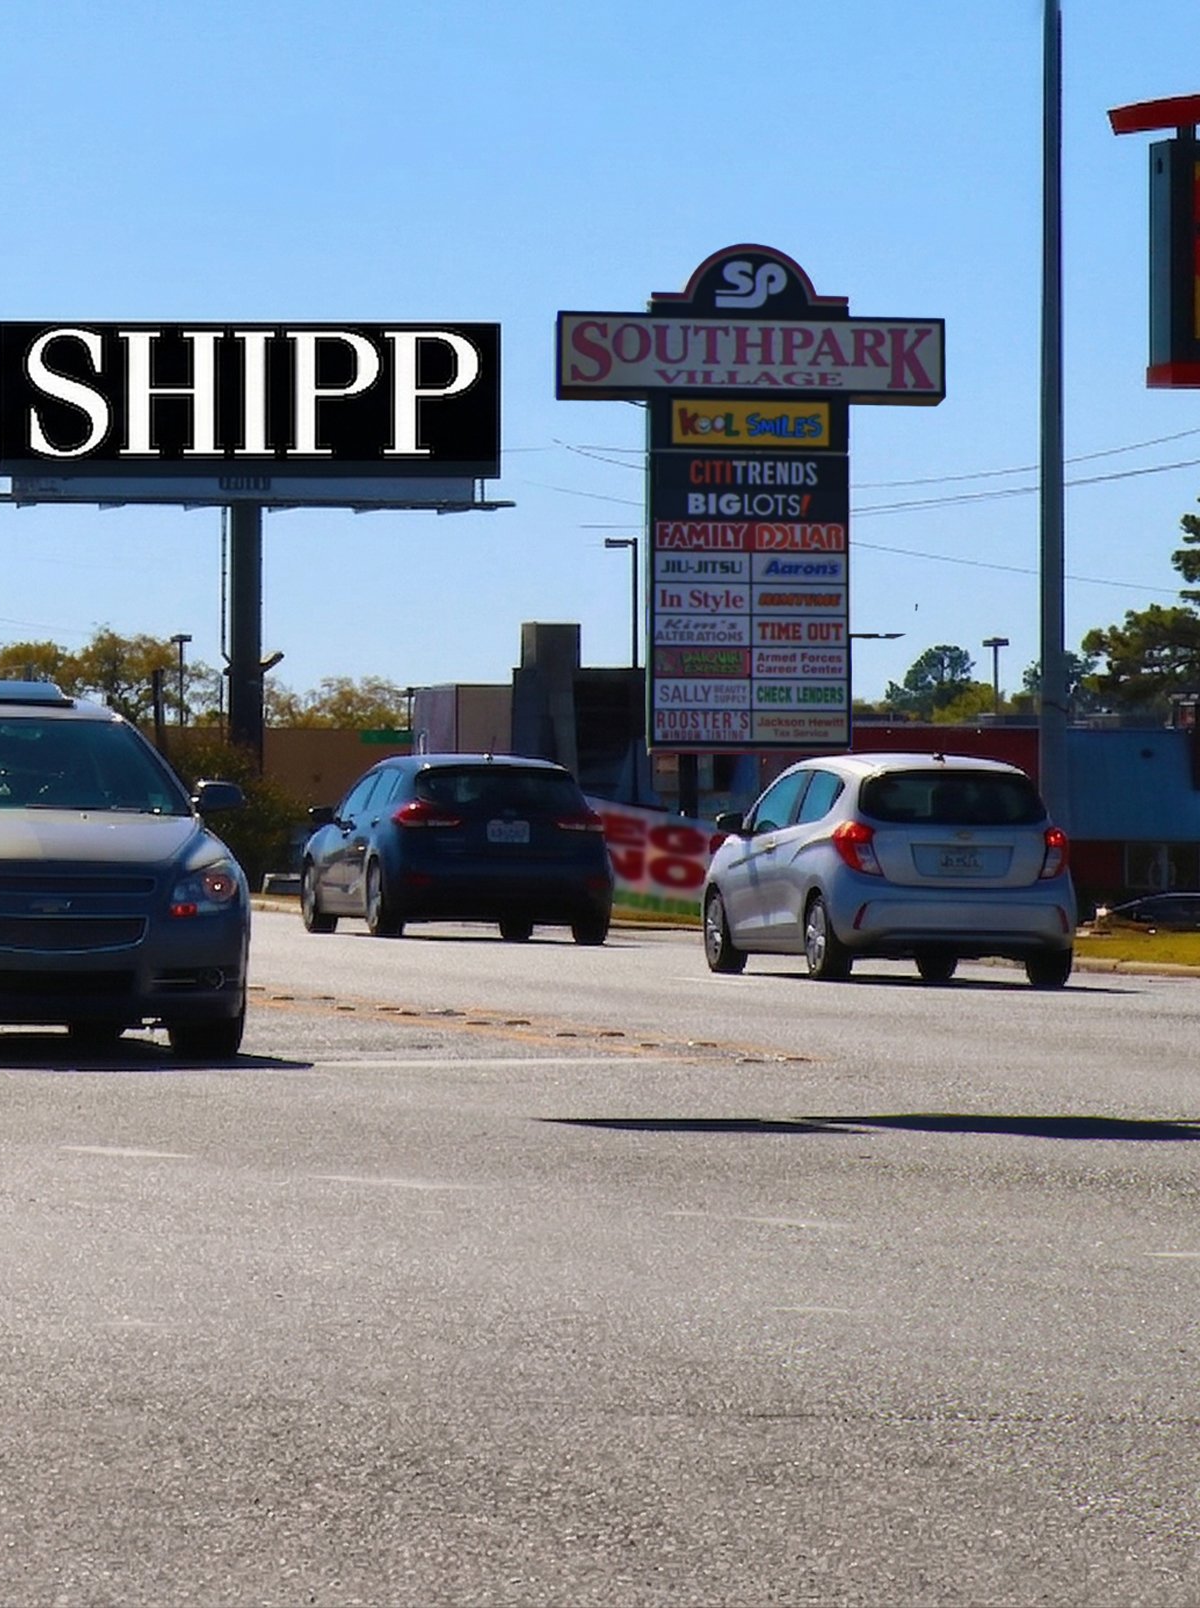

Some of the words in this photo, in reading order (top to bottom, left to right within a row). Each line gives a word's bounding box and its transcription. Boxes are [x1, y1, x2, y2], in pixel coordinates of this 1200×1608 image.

[570, 320, 934, 390] SOUTHPARK
[655, 369, 842, 387] VILLAGE
[26, 328, 480, 458] SHIPP
[656, 521, 750, 549] FAMILY
[755, 522, 845, 550] DOLLAR
[660, 560, 742, 574] JIU-JITSU
[660, 589, 682, 608] In
[689, 589, 744, 613] Style
[655, 631, 743, 642] ALTERATIONS
[757, 622, 802, 641] TIME
[807, 622, 843, 641] OUT
[757, 653, 797, 662] Armed
[800, 653, 842, 663] Forces
[756, 663, 797, 674] Career
[801, 664, 843, 674] Center
[659, 685, 711, 703] SALLY
[756, 686, 793, 703] CHECK
[796, 686, 844, 704] LENDERS
[656, 711, 749, 730] ROOSTER'S
[757, 717, 805, 727] Jackson
